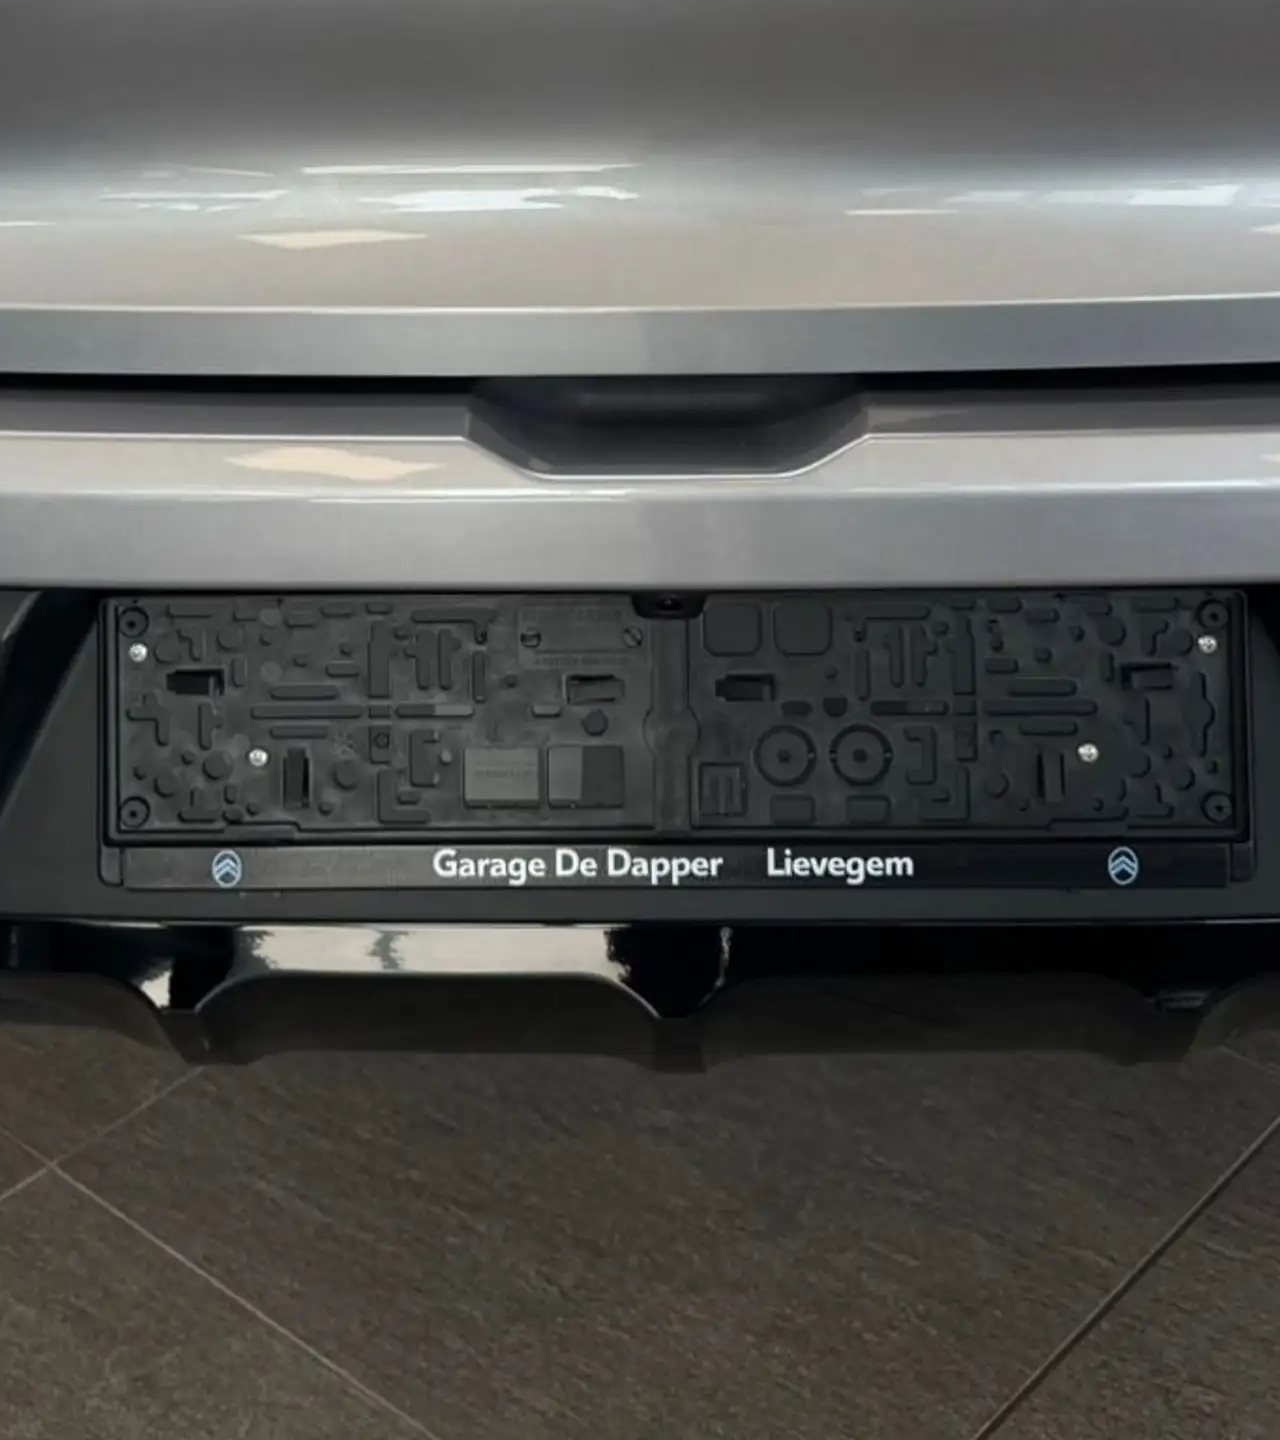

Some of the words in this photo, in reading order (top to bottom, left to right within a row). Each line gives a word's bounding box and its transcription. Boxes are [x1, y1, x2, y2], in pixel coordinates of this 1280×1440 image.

[432, 848, 546, 885] Garage
[554, 849, 598, 877] De
[606, 849, 724, 885] Dapper
[766, 847, 915, 884] Lievegem
